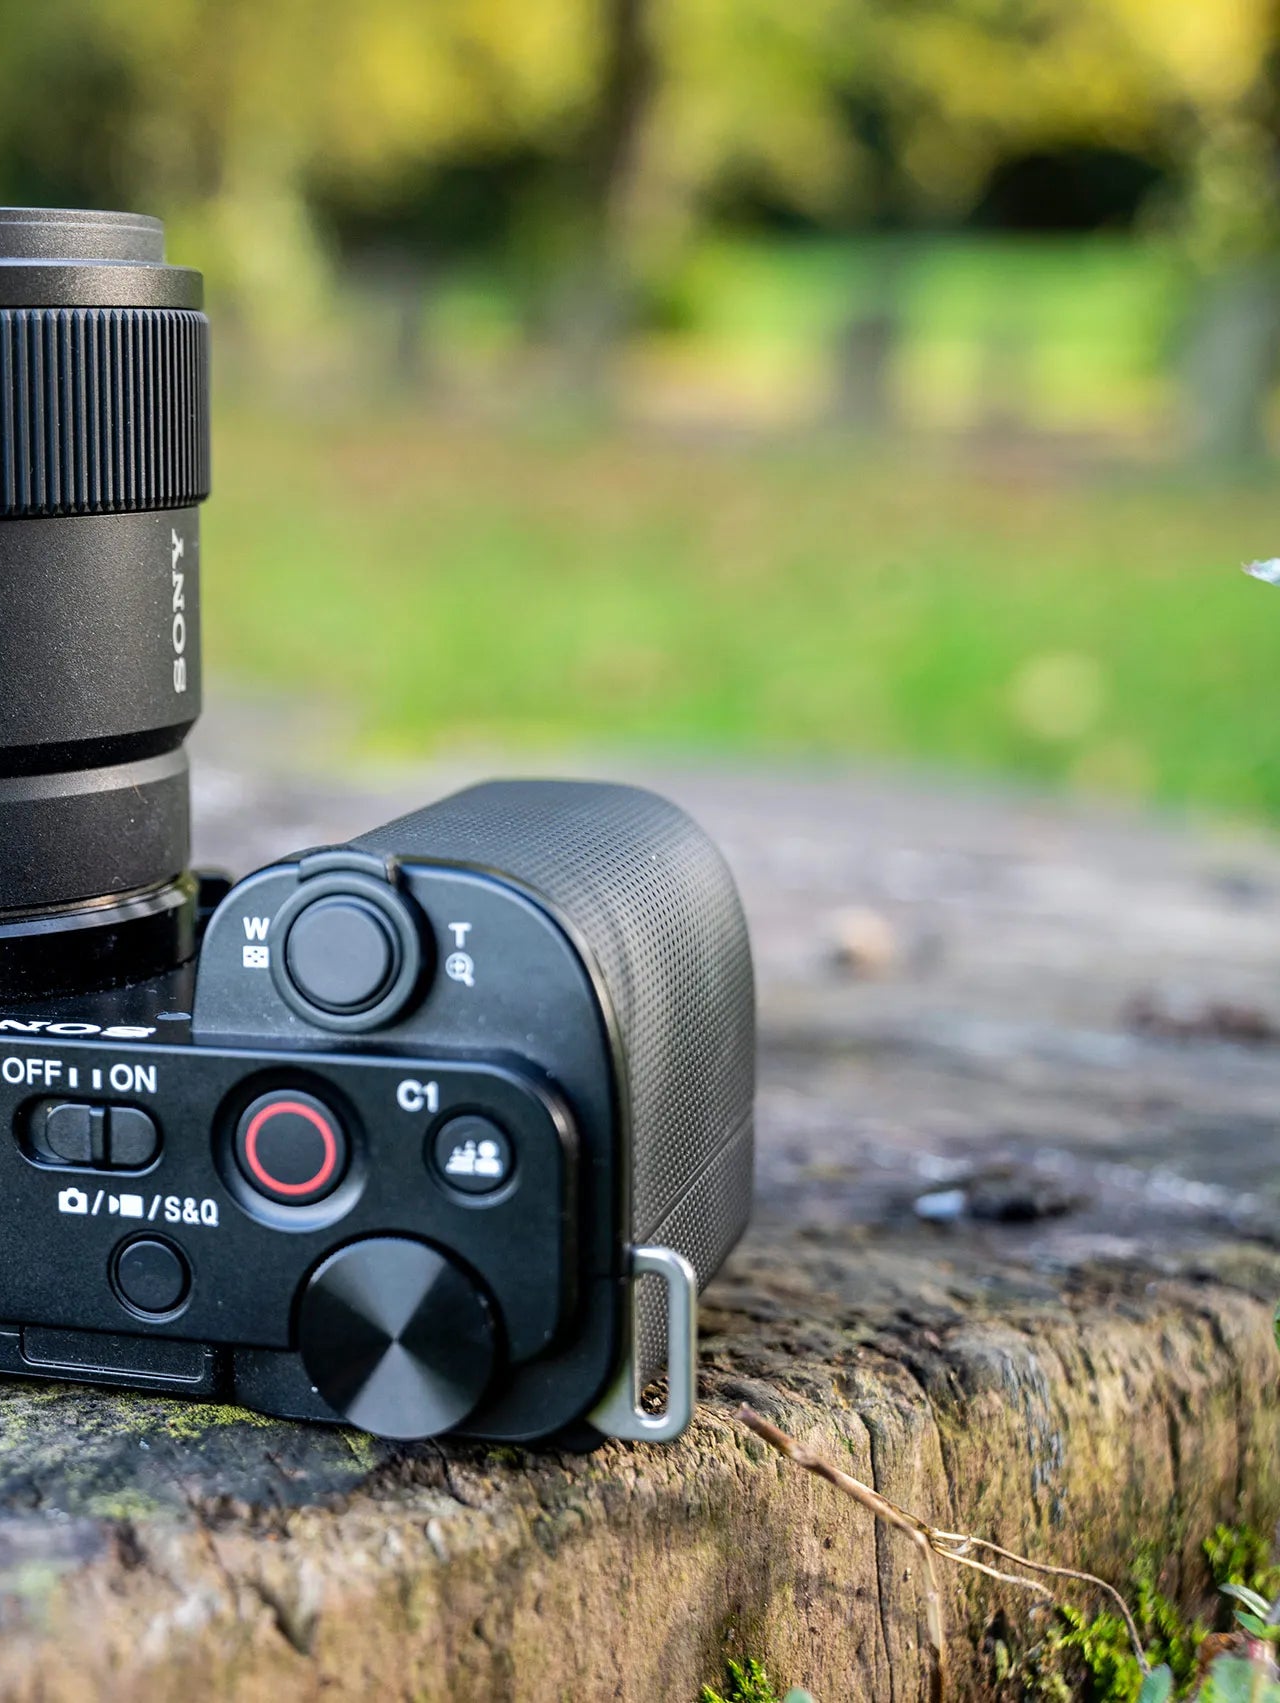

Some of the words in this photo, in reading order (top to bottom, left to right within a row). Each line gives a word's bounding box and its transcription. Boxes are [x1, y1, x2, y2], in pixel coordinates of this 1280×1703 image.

[171, 528, 187, 694] SONY
[242, 916, 270, 941] W
[448, 922, 472, 949] T
[1, 1056, 62, 1087] OFF
[109, 1063, 158, 1094] ON
[396, 1079, 440, 1114] C1
